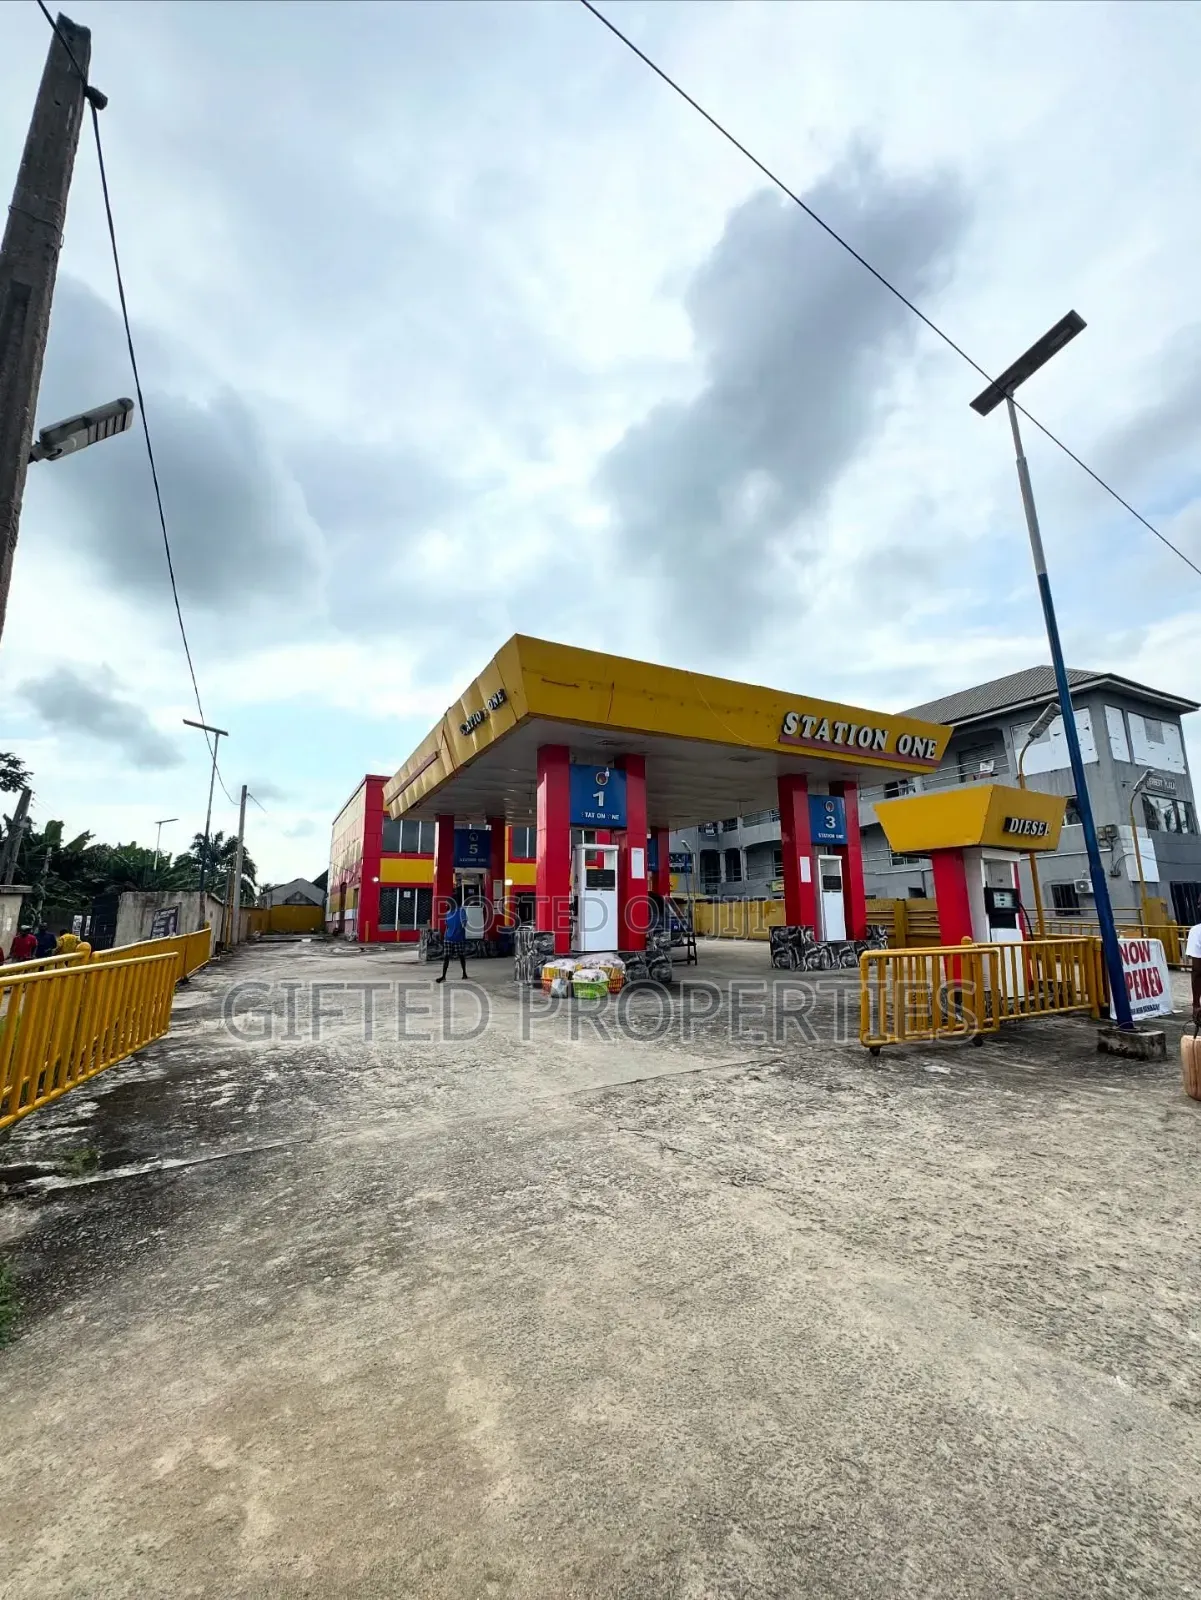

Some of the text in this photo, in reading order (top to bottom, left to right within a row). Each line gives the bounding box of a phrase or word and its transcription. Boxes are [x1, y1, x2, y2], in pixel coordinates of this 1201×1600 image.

[782, 711, 938, 760] STATION ONE
[592, 790, 605, 807] 1
[825, 815, 836, 829] 3
[1006, 817, 1050, 836] DIESEL
[469, 843, 479, 855] 5
[1119, 940, 1151, 965] NOW
[1124, 966, 1164, 1002] PENED
